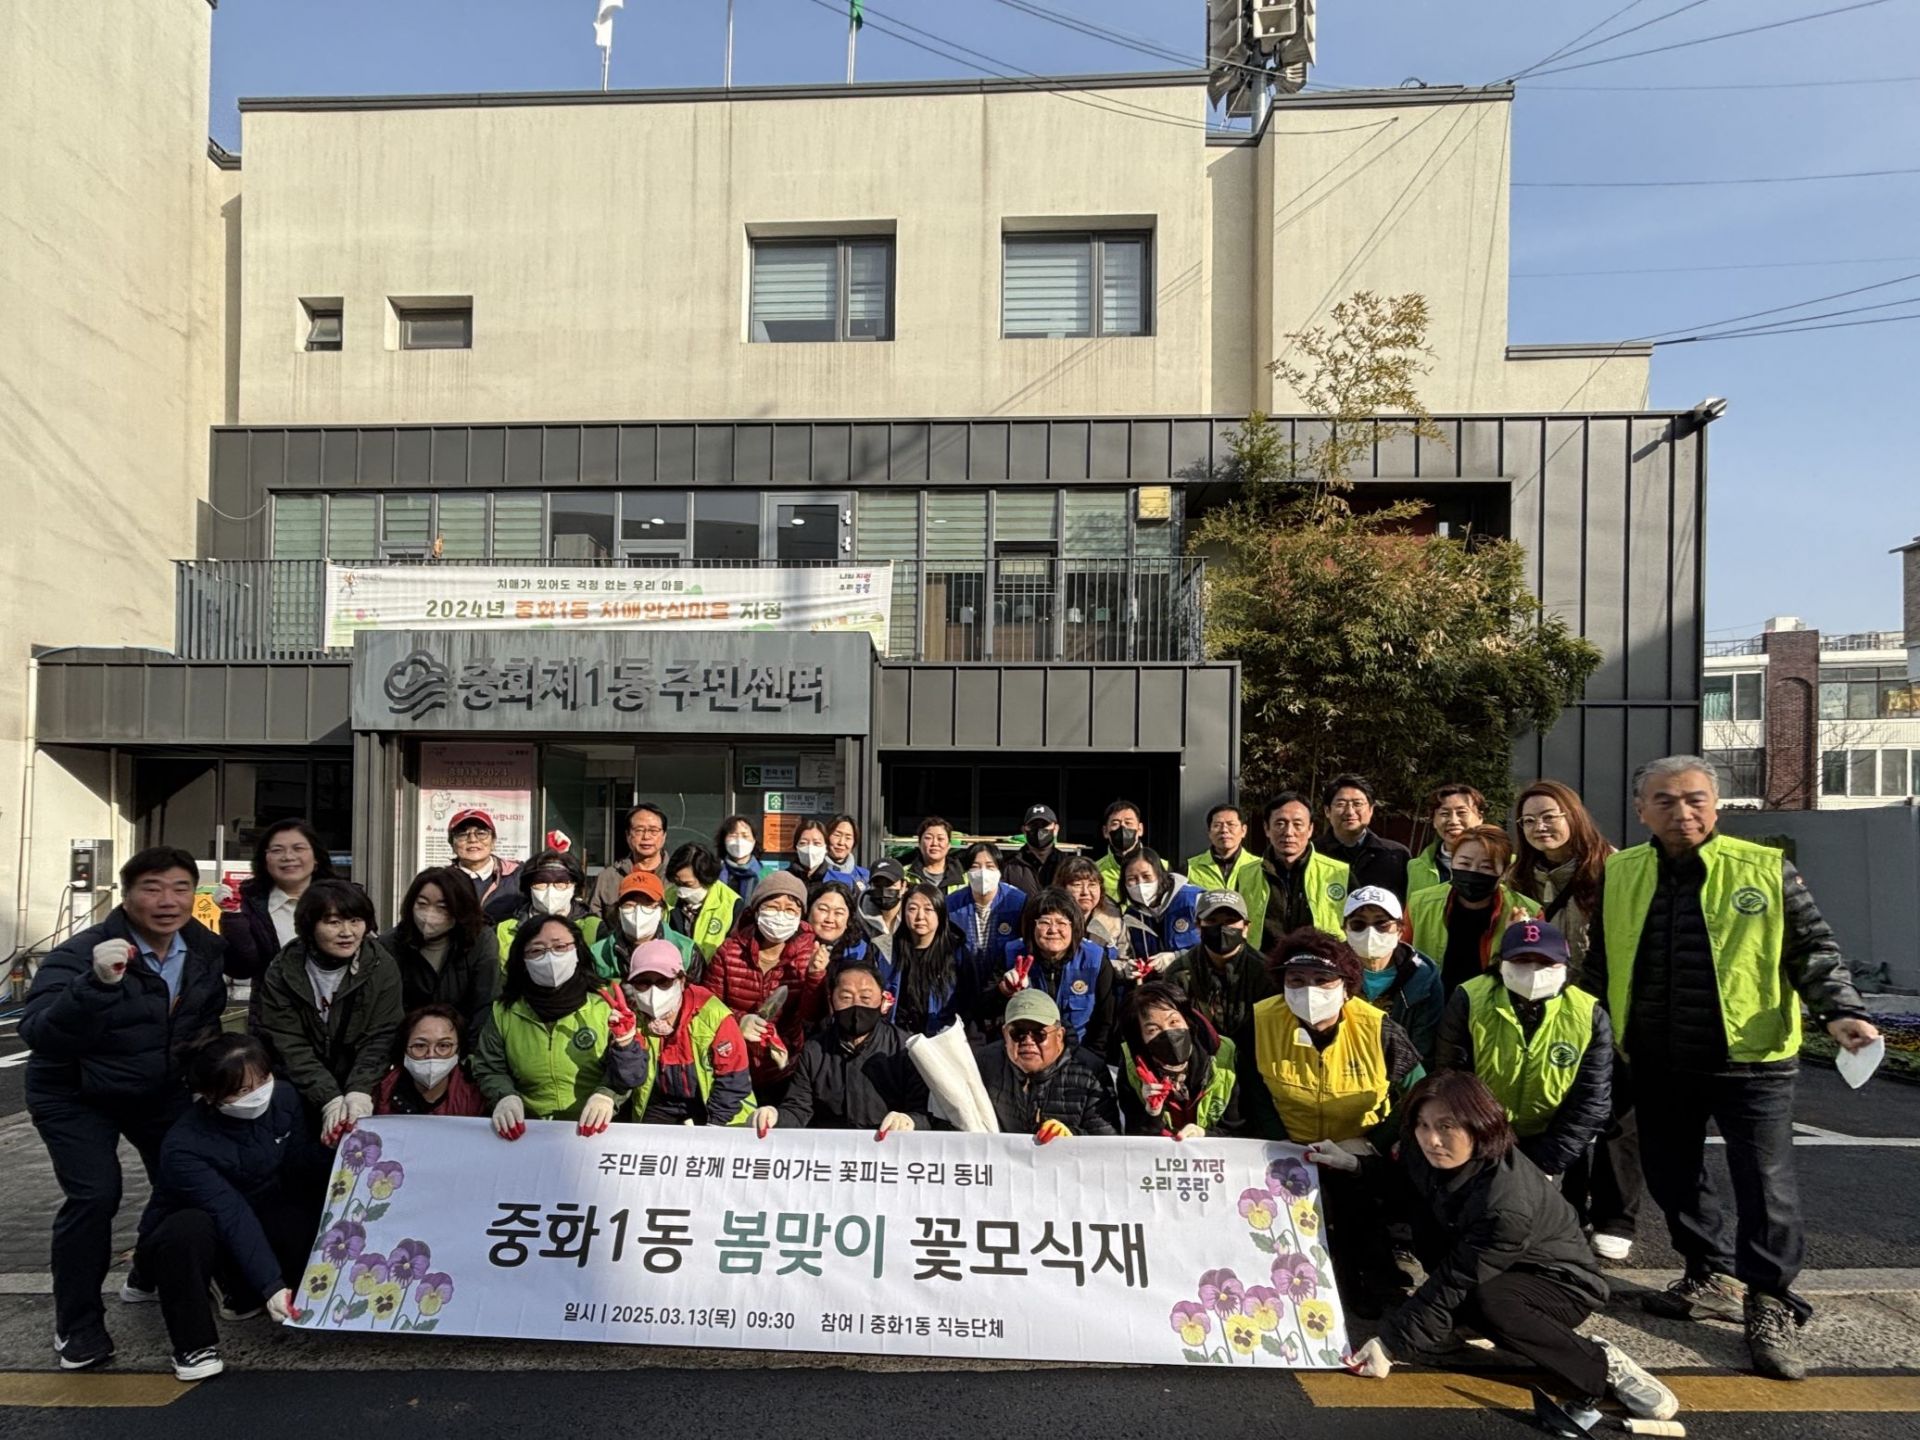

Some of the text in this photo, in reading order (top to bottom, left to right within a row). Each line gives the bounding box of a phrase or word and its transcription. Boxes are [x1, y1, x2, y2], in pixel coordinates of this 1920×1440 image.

[496, 578, 684, 592] 치매가 있어도 걱정 없는 우리 마을
[425, 599, 505, 619] 2024년
[515, 600, 590, 620] 중화1동
[739, 601, 783, 620] 지정
[1523, 925, 1541, 943] B
[597, 1153, 993, 1187] 주민들이 함께 만들어가는 꽃피는 우리 동네
[1154, 1157, 1226, 1184] 나의 자랑
[1139, 1175, 1211, 1203] 우리 중랑
[485, 1202, 1149, 1289] 중화1동 봄맞이 꽃모식재
[564, 1302, 596, 1323] 일시
[610, 1305, 737, 1330] 2025.03.13(목)
[746, 1310, 795, 1330] 09:30
[820, 1312, 853, 1334] 참여
[870, 1314, 931, 1337] 중화1동
[937, 1317, 1004, 1339] 직능단체
